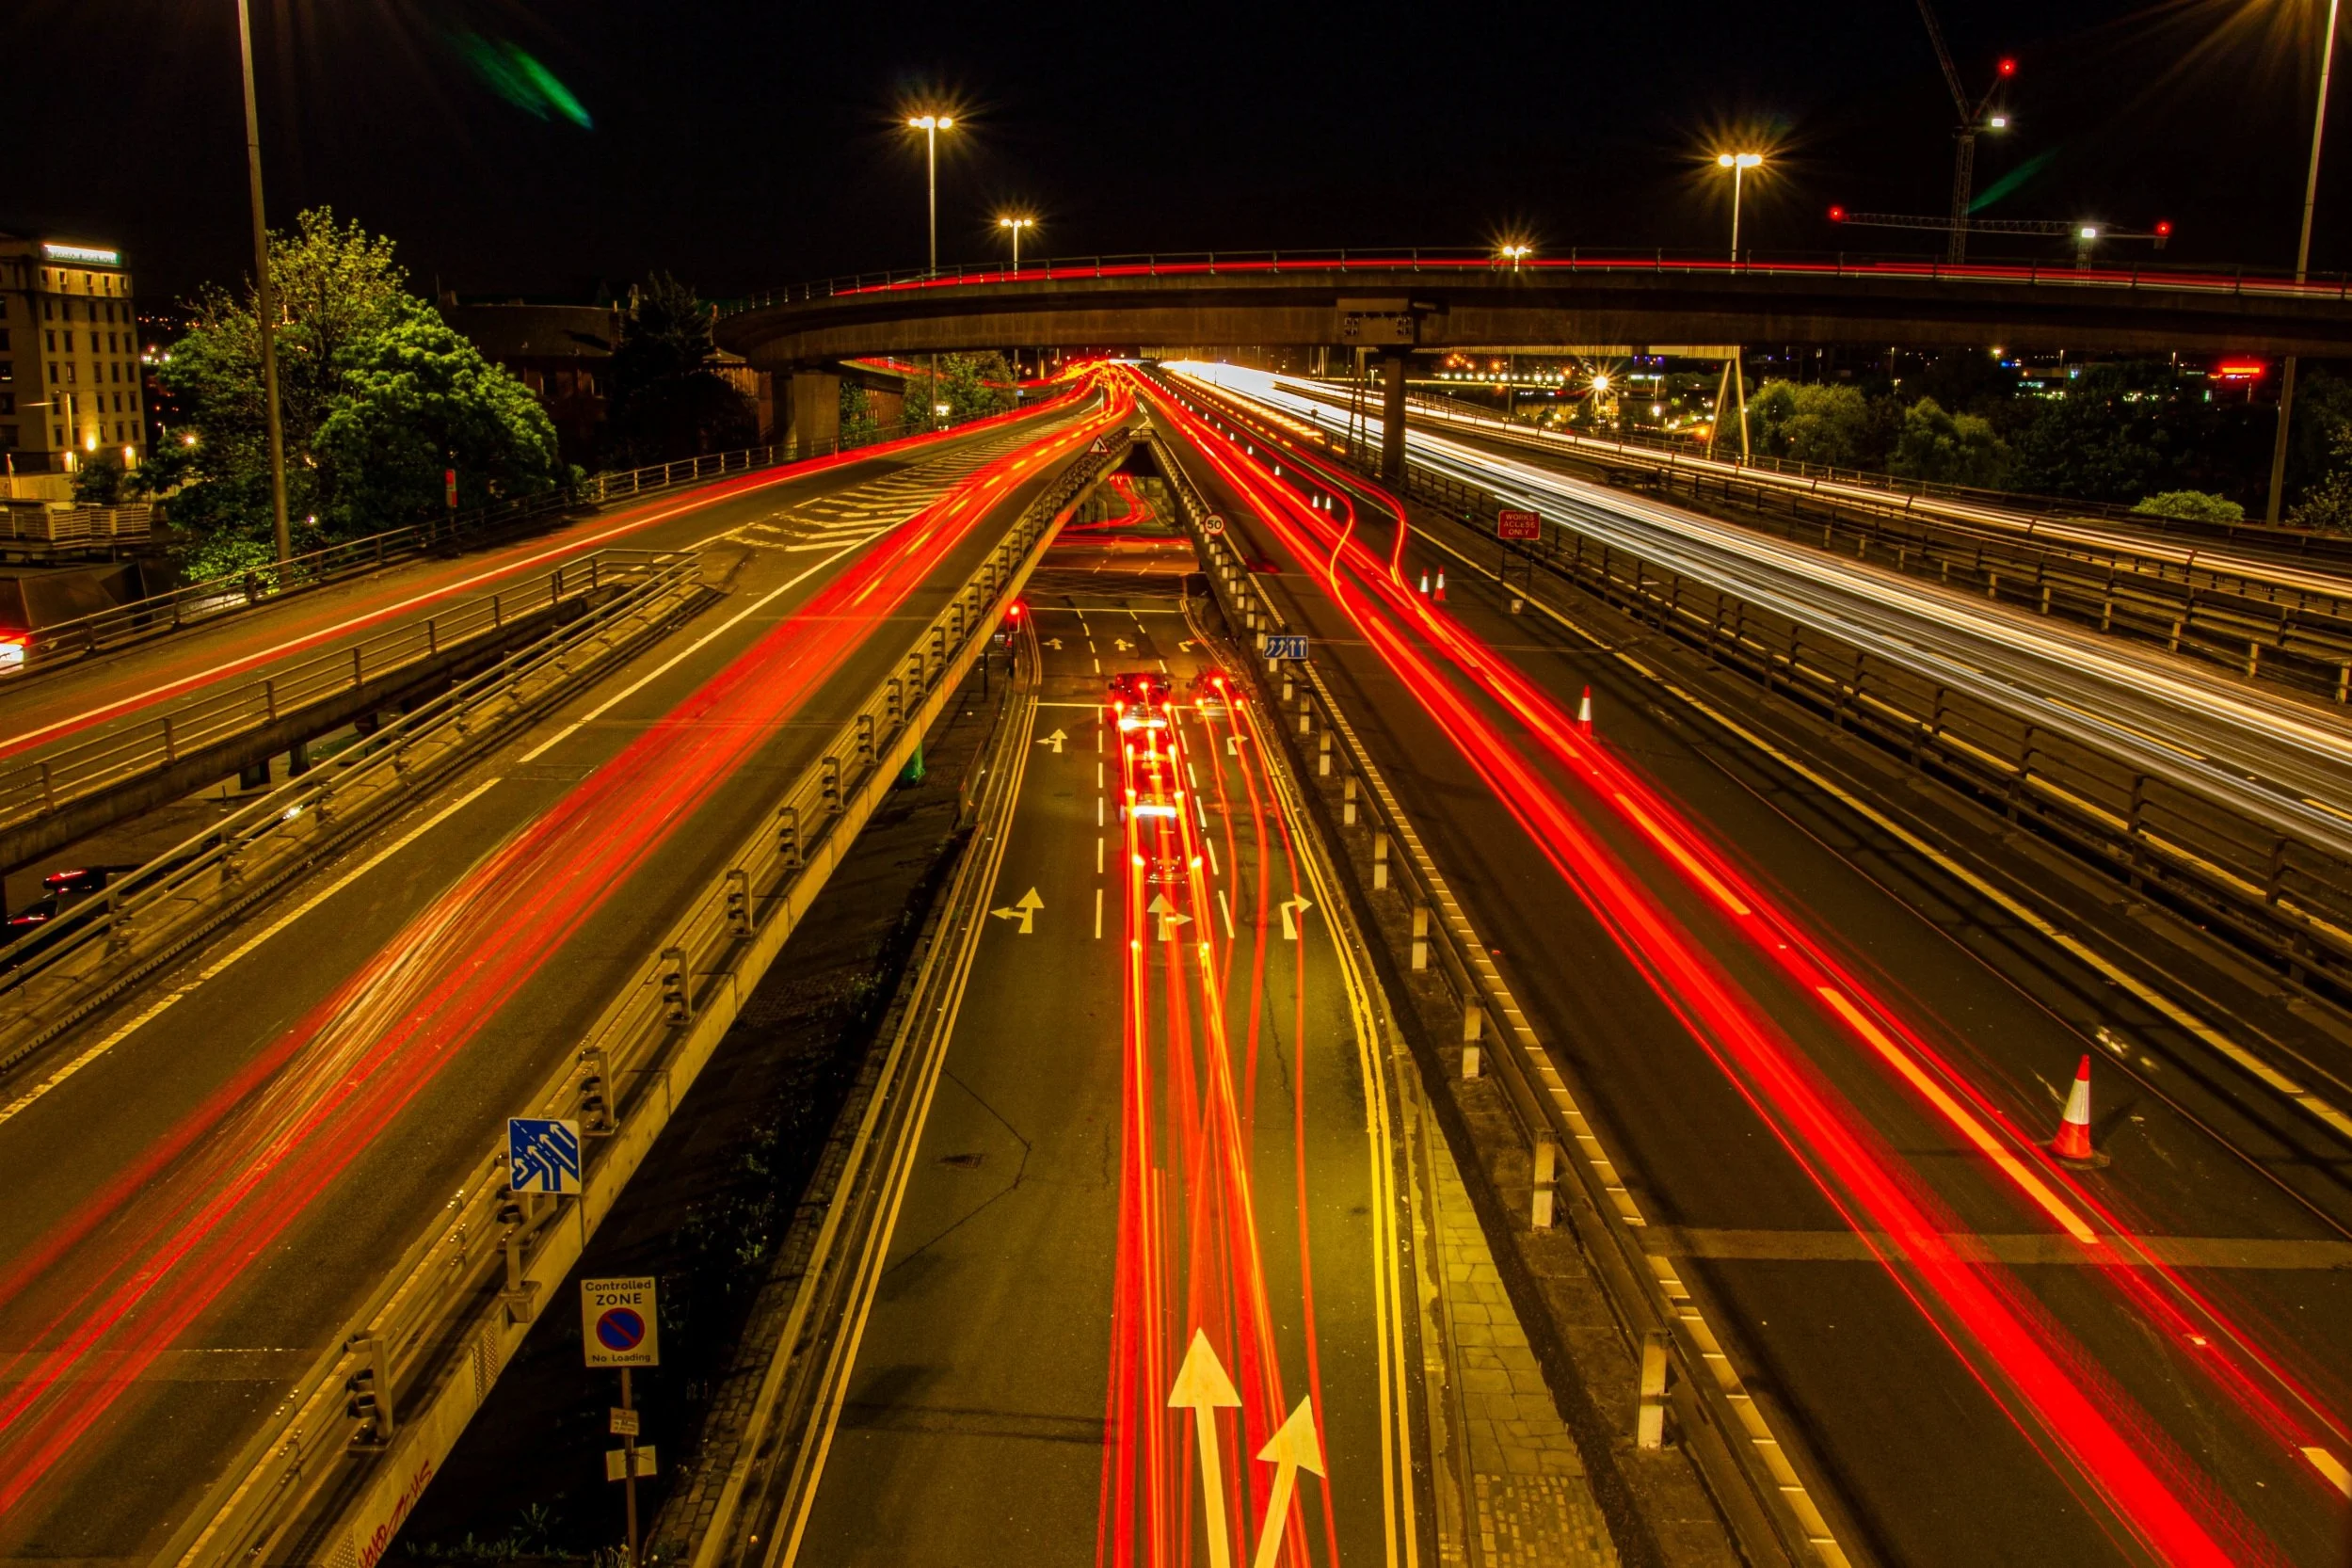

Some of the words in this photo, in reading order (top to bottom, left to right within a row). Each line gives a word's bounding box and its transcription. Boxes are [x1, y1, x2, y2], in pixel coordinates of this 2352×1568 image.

[1208, 520, 1223, 530] 50
[585, 1280, 651, 1291] Controlled
[596, 1293, 642, 1305] ZONE
[612, 1353, 650, 1362] Loading
